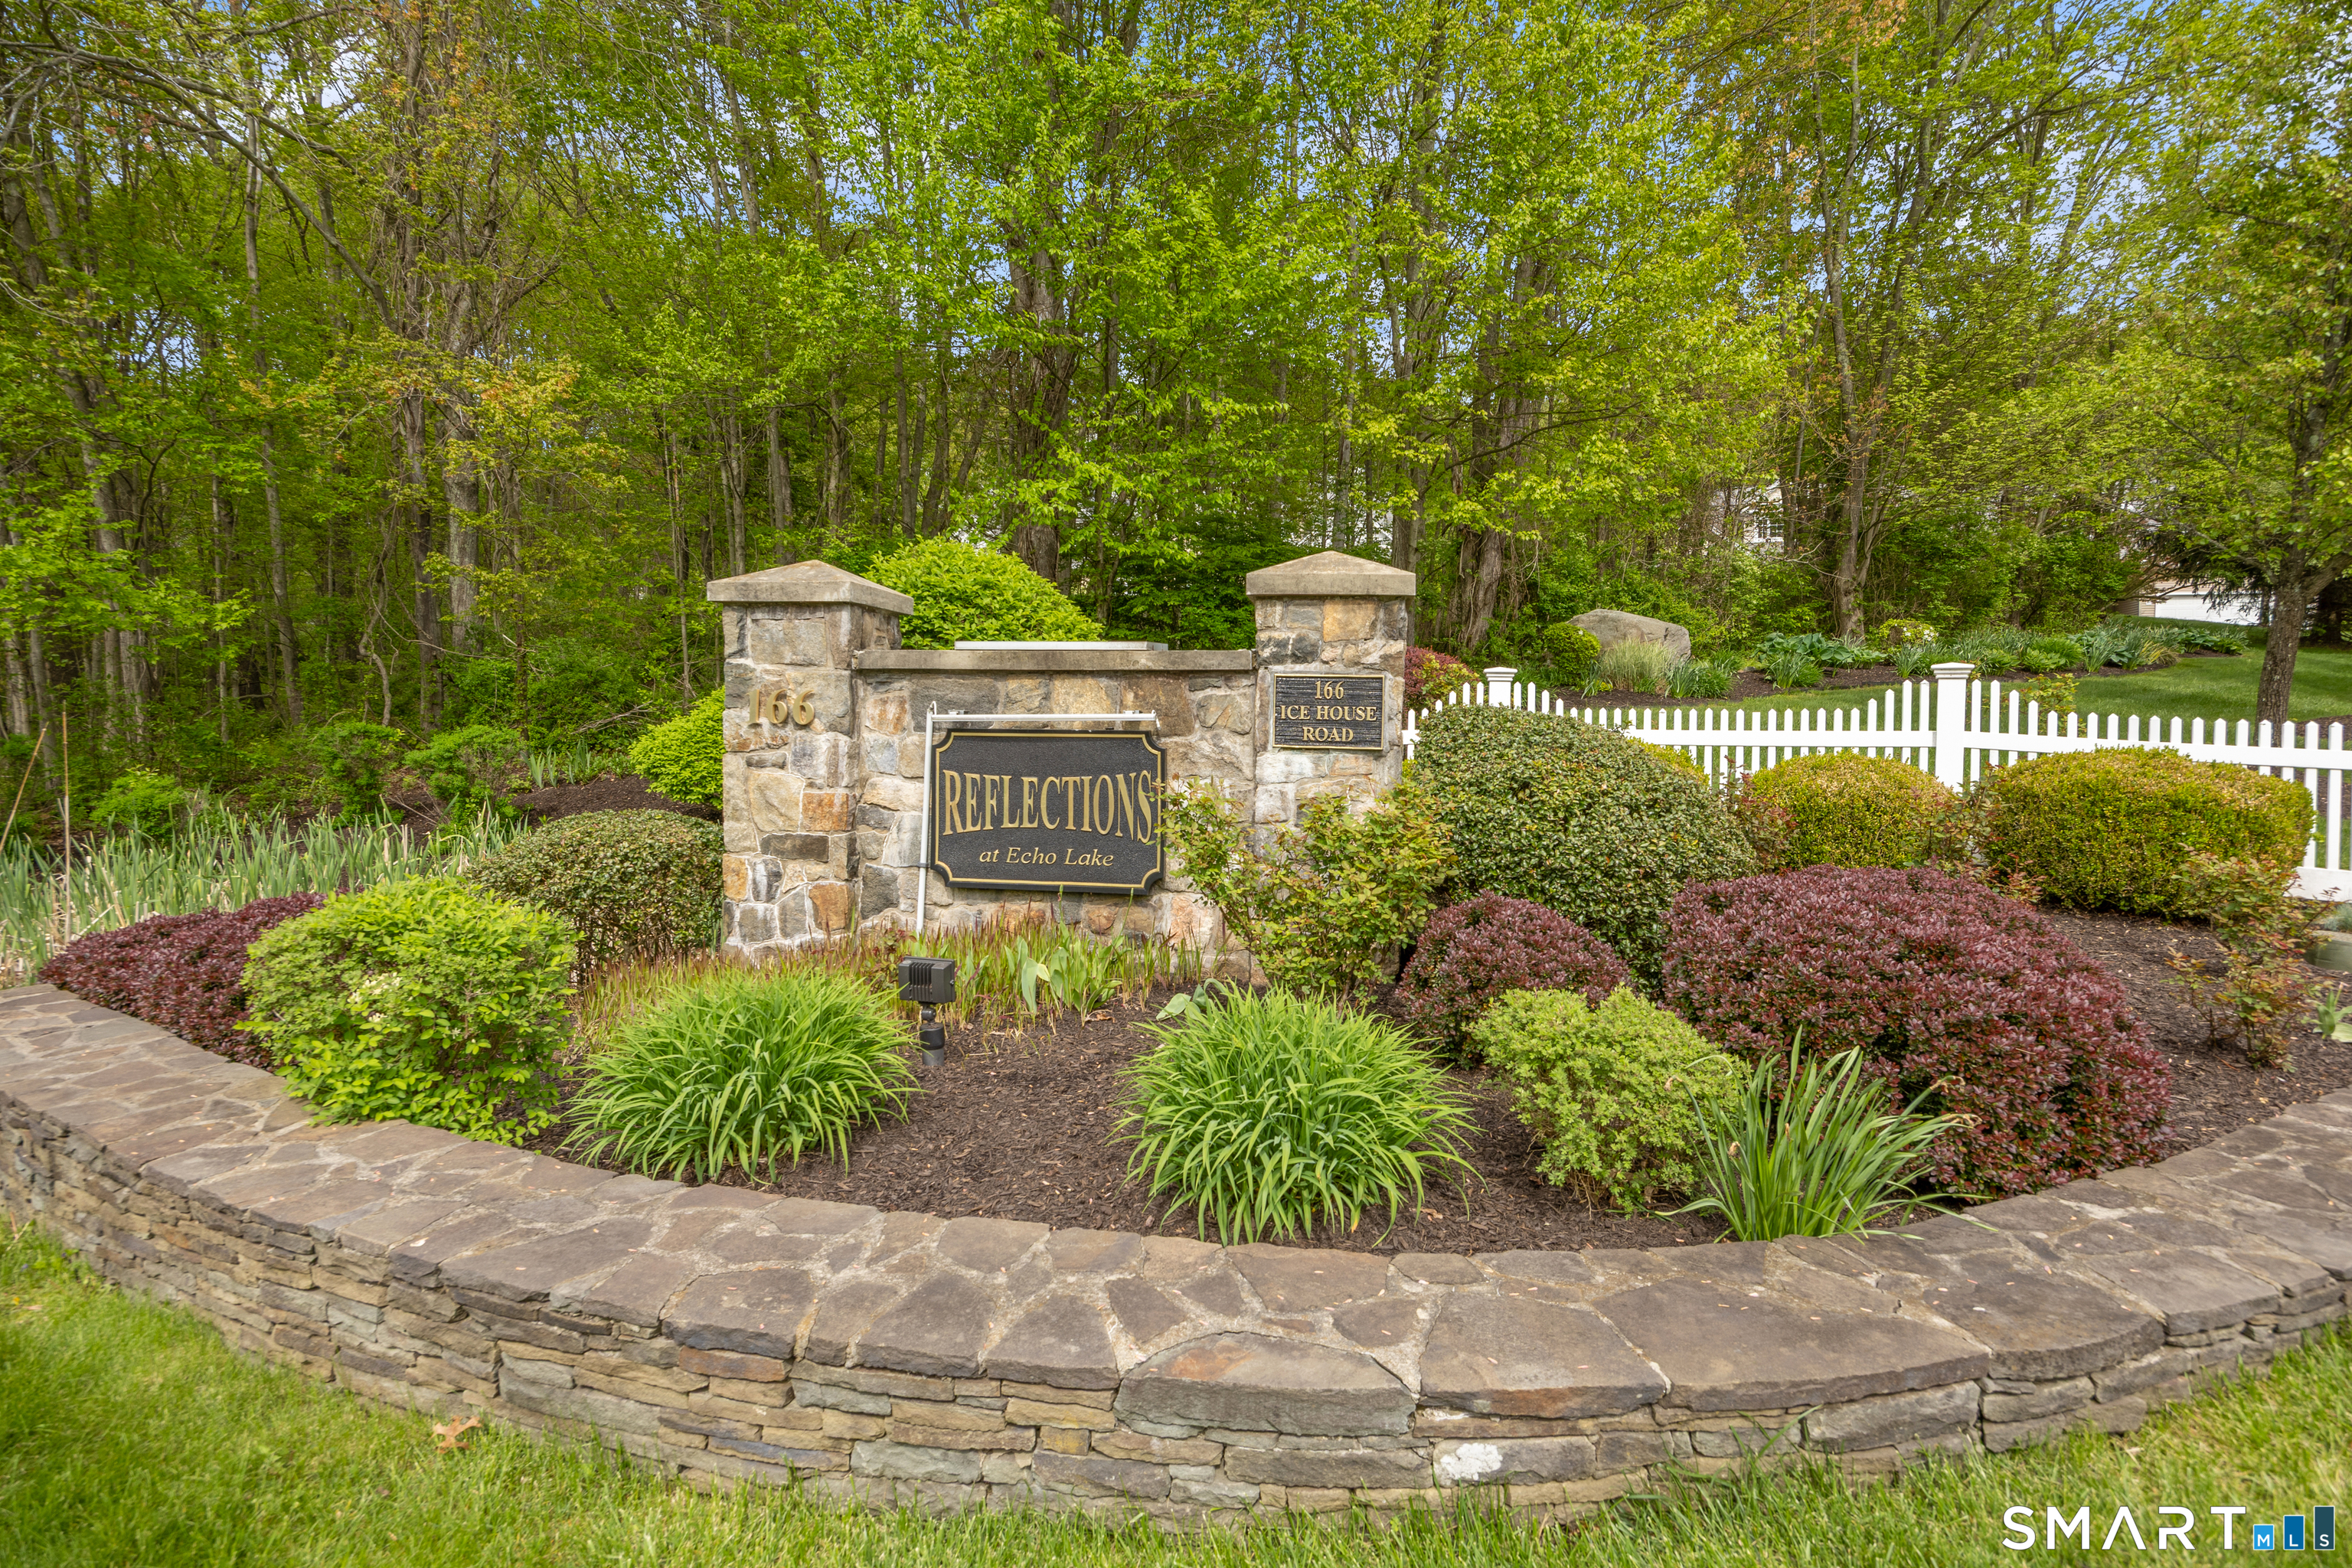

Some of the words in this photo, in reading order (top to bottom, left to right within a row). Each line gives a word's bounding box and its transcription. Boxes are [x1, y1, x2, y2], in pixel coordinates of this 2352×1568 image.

[1315, 680, 1344, 700] 166
[745, 688, 815, 726] 166
[1280, 705, 1311, 720] ICE
[1315, 705, 1377, 721] HOUSE
[1302, 727, 1354, 742] ROAD
[942, 769, 1152, 844] REFLECTIONS
[978, 848, 1000, 864] at
[1006, 847, 1057, 865] Echo
[1063, 848, 1115, 867] Lake
